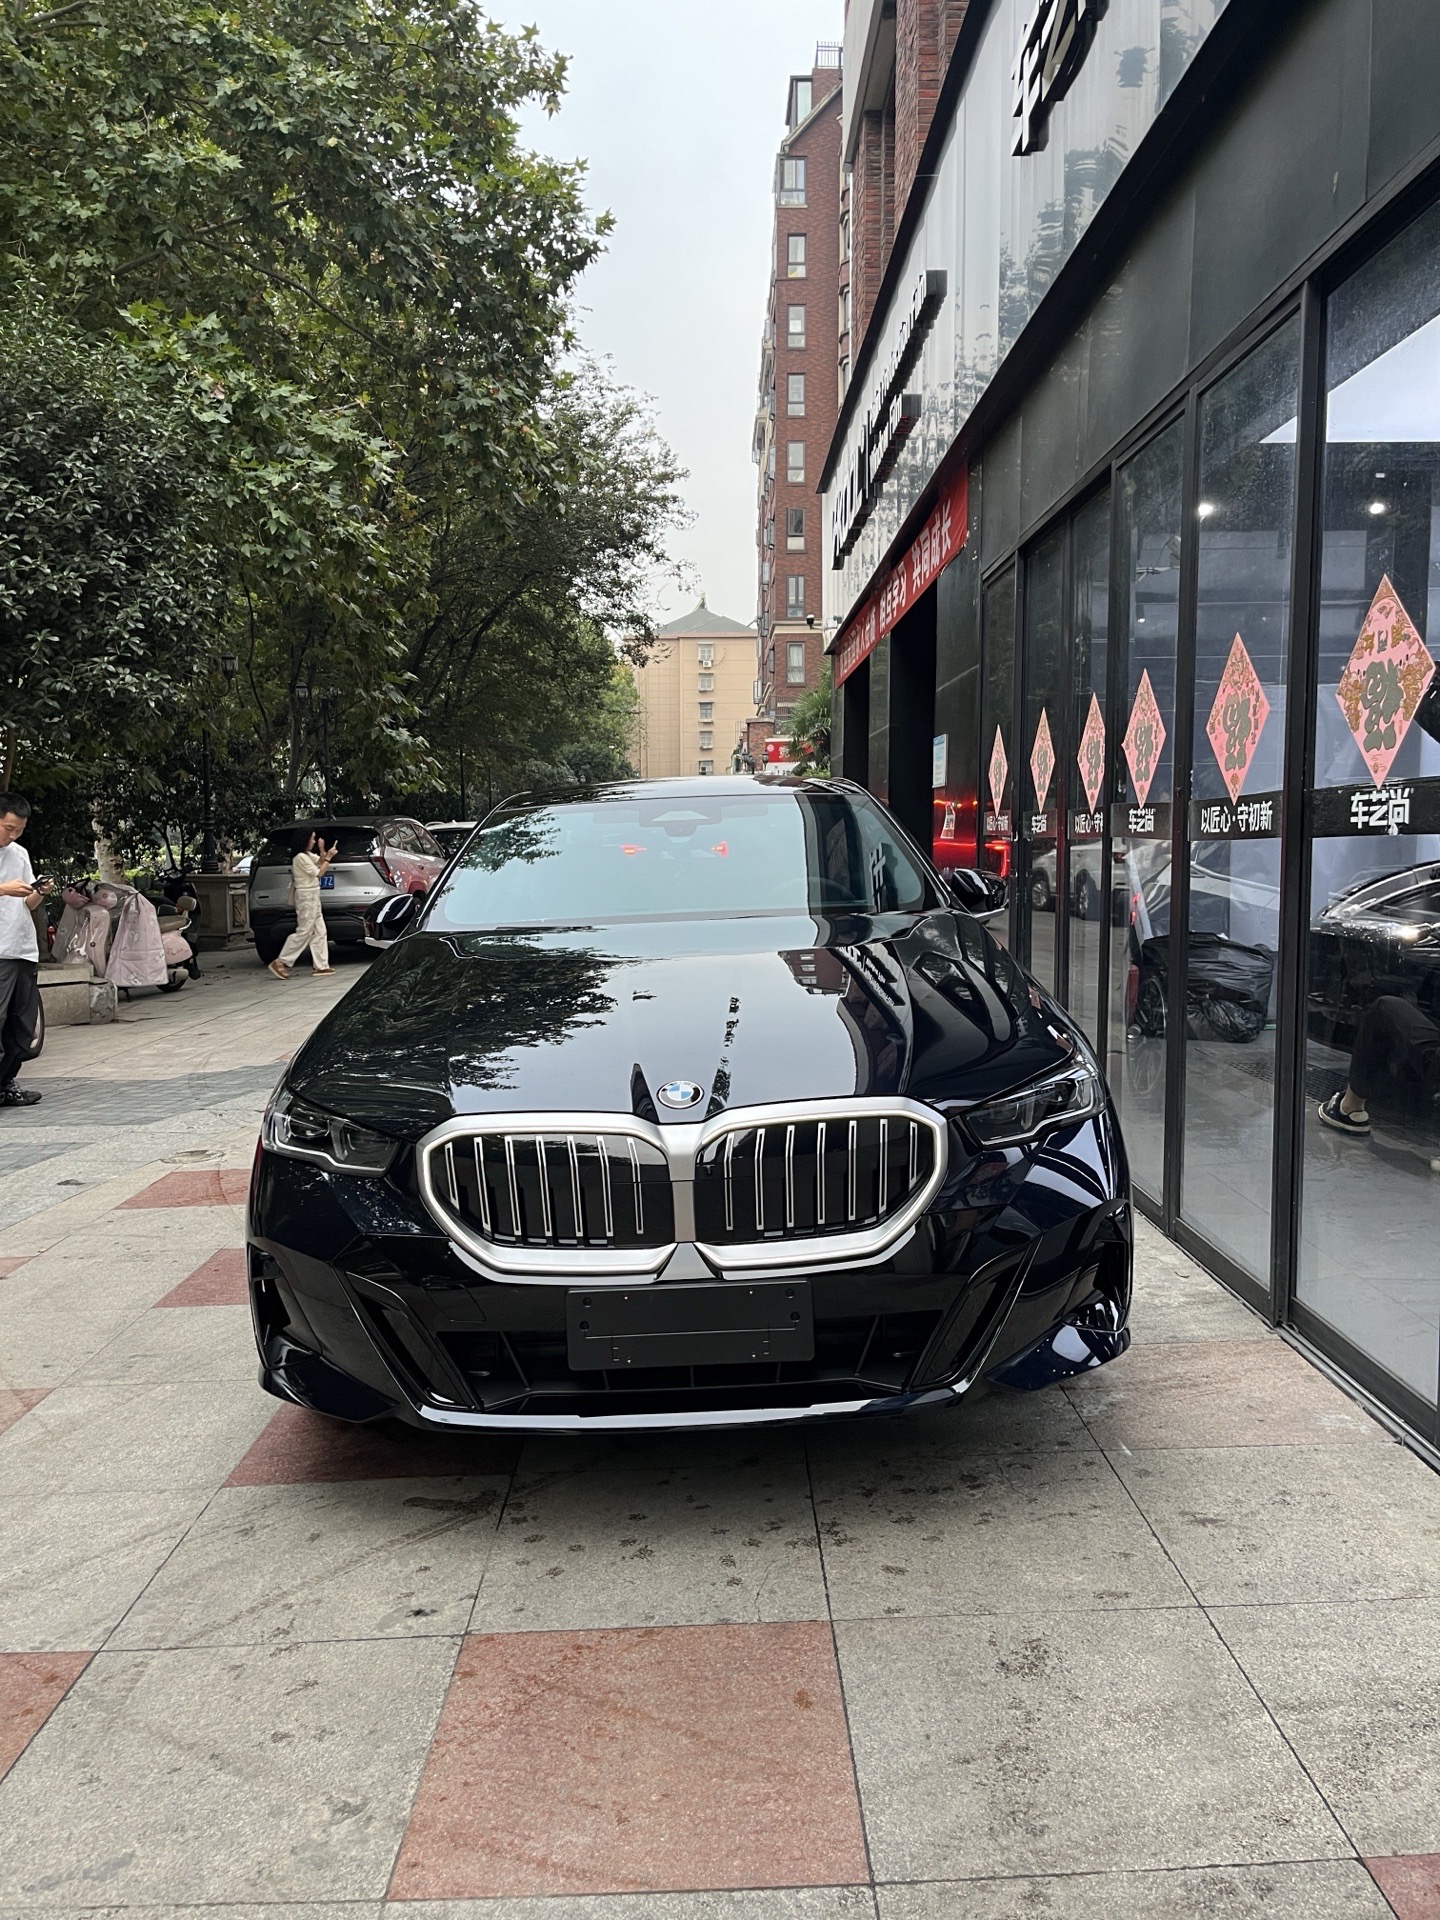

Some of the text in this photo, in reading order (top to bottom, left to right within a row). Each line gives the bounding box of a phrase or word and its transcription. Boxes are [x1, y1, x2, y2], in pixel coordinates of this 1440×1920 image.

[879, 499, 952, 633] 相互学习 共同成长
[1129, 808, 1155, 833] 车艺尚
[1350, 788, 1410, 829] 车艺尚
